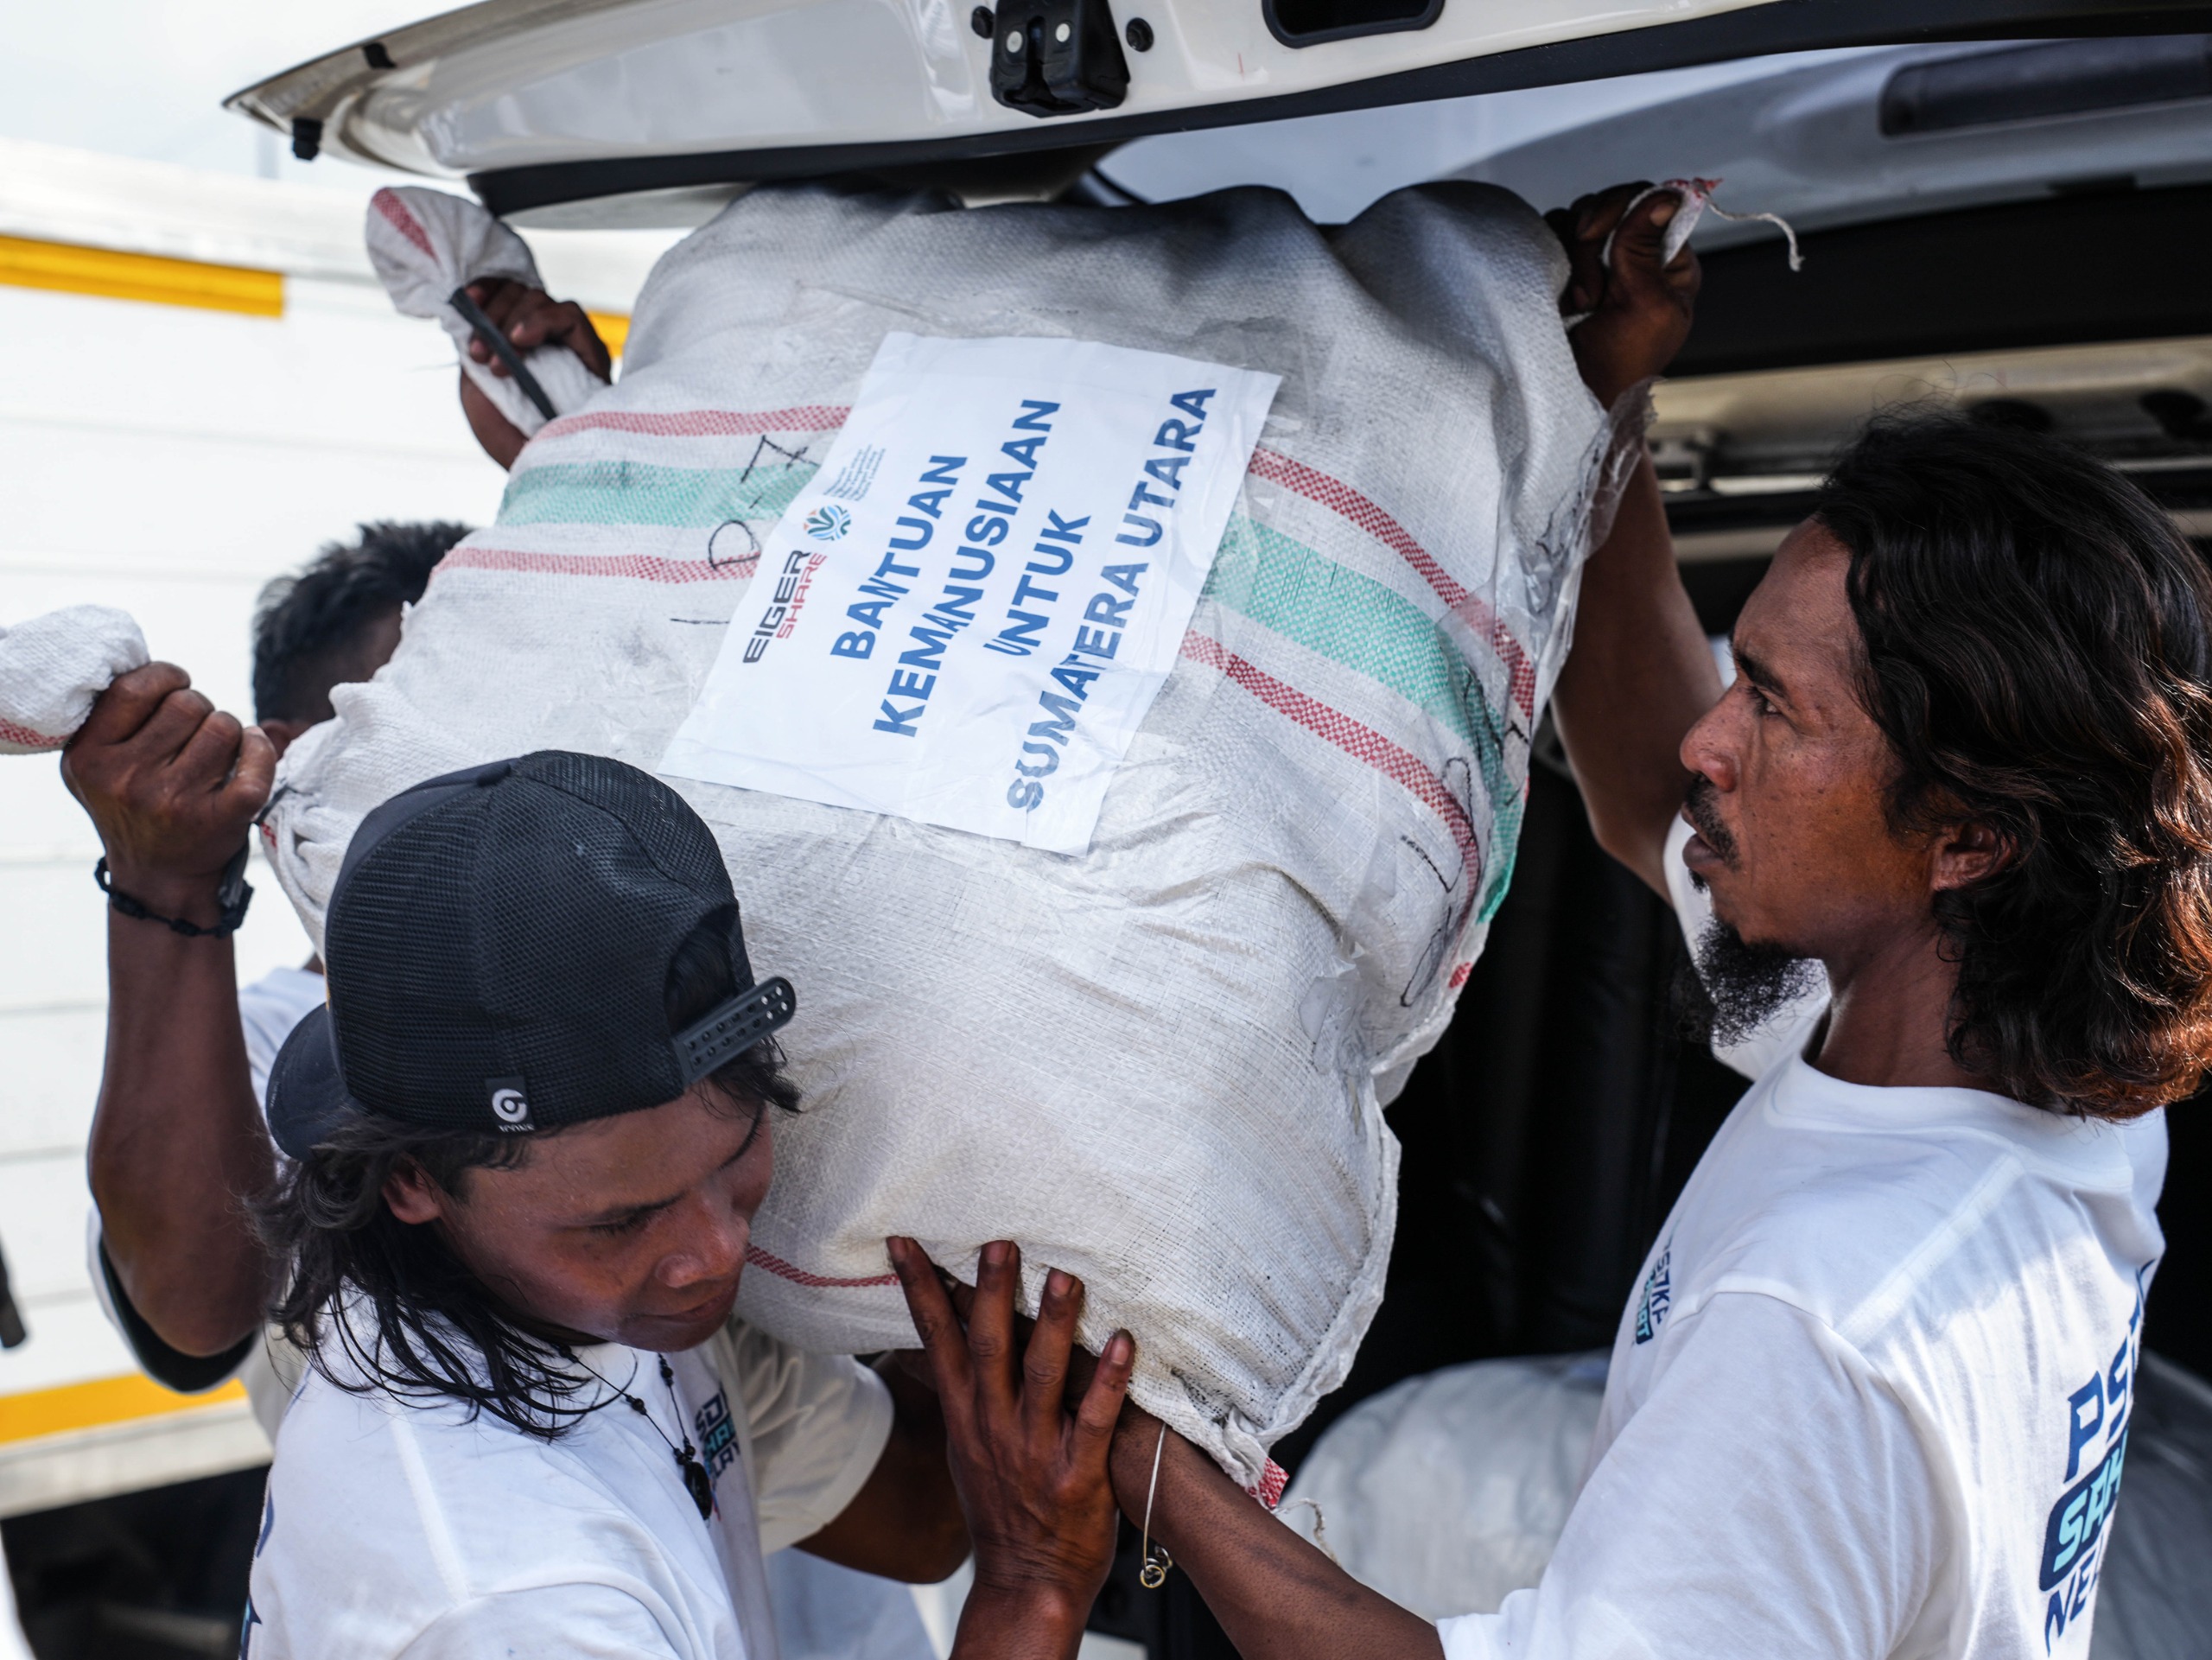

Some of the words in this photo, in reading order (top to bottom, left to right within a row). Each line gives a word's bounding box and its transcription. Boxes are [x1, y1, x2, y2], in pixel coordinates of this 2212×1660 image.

[742, 550, 811, 664] EIGER
[776, 552, 828, 639] SHARE
[830, 455, 969, 660] BANTUAN
[873, 398, 1062, 737] KEMANUSIAAN
[982, 508, 1092, 658] UNTUK
[1007, 563, 1149, 812] SUMATERA
[1116, 388, 1217, 549] UTARA
